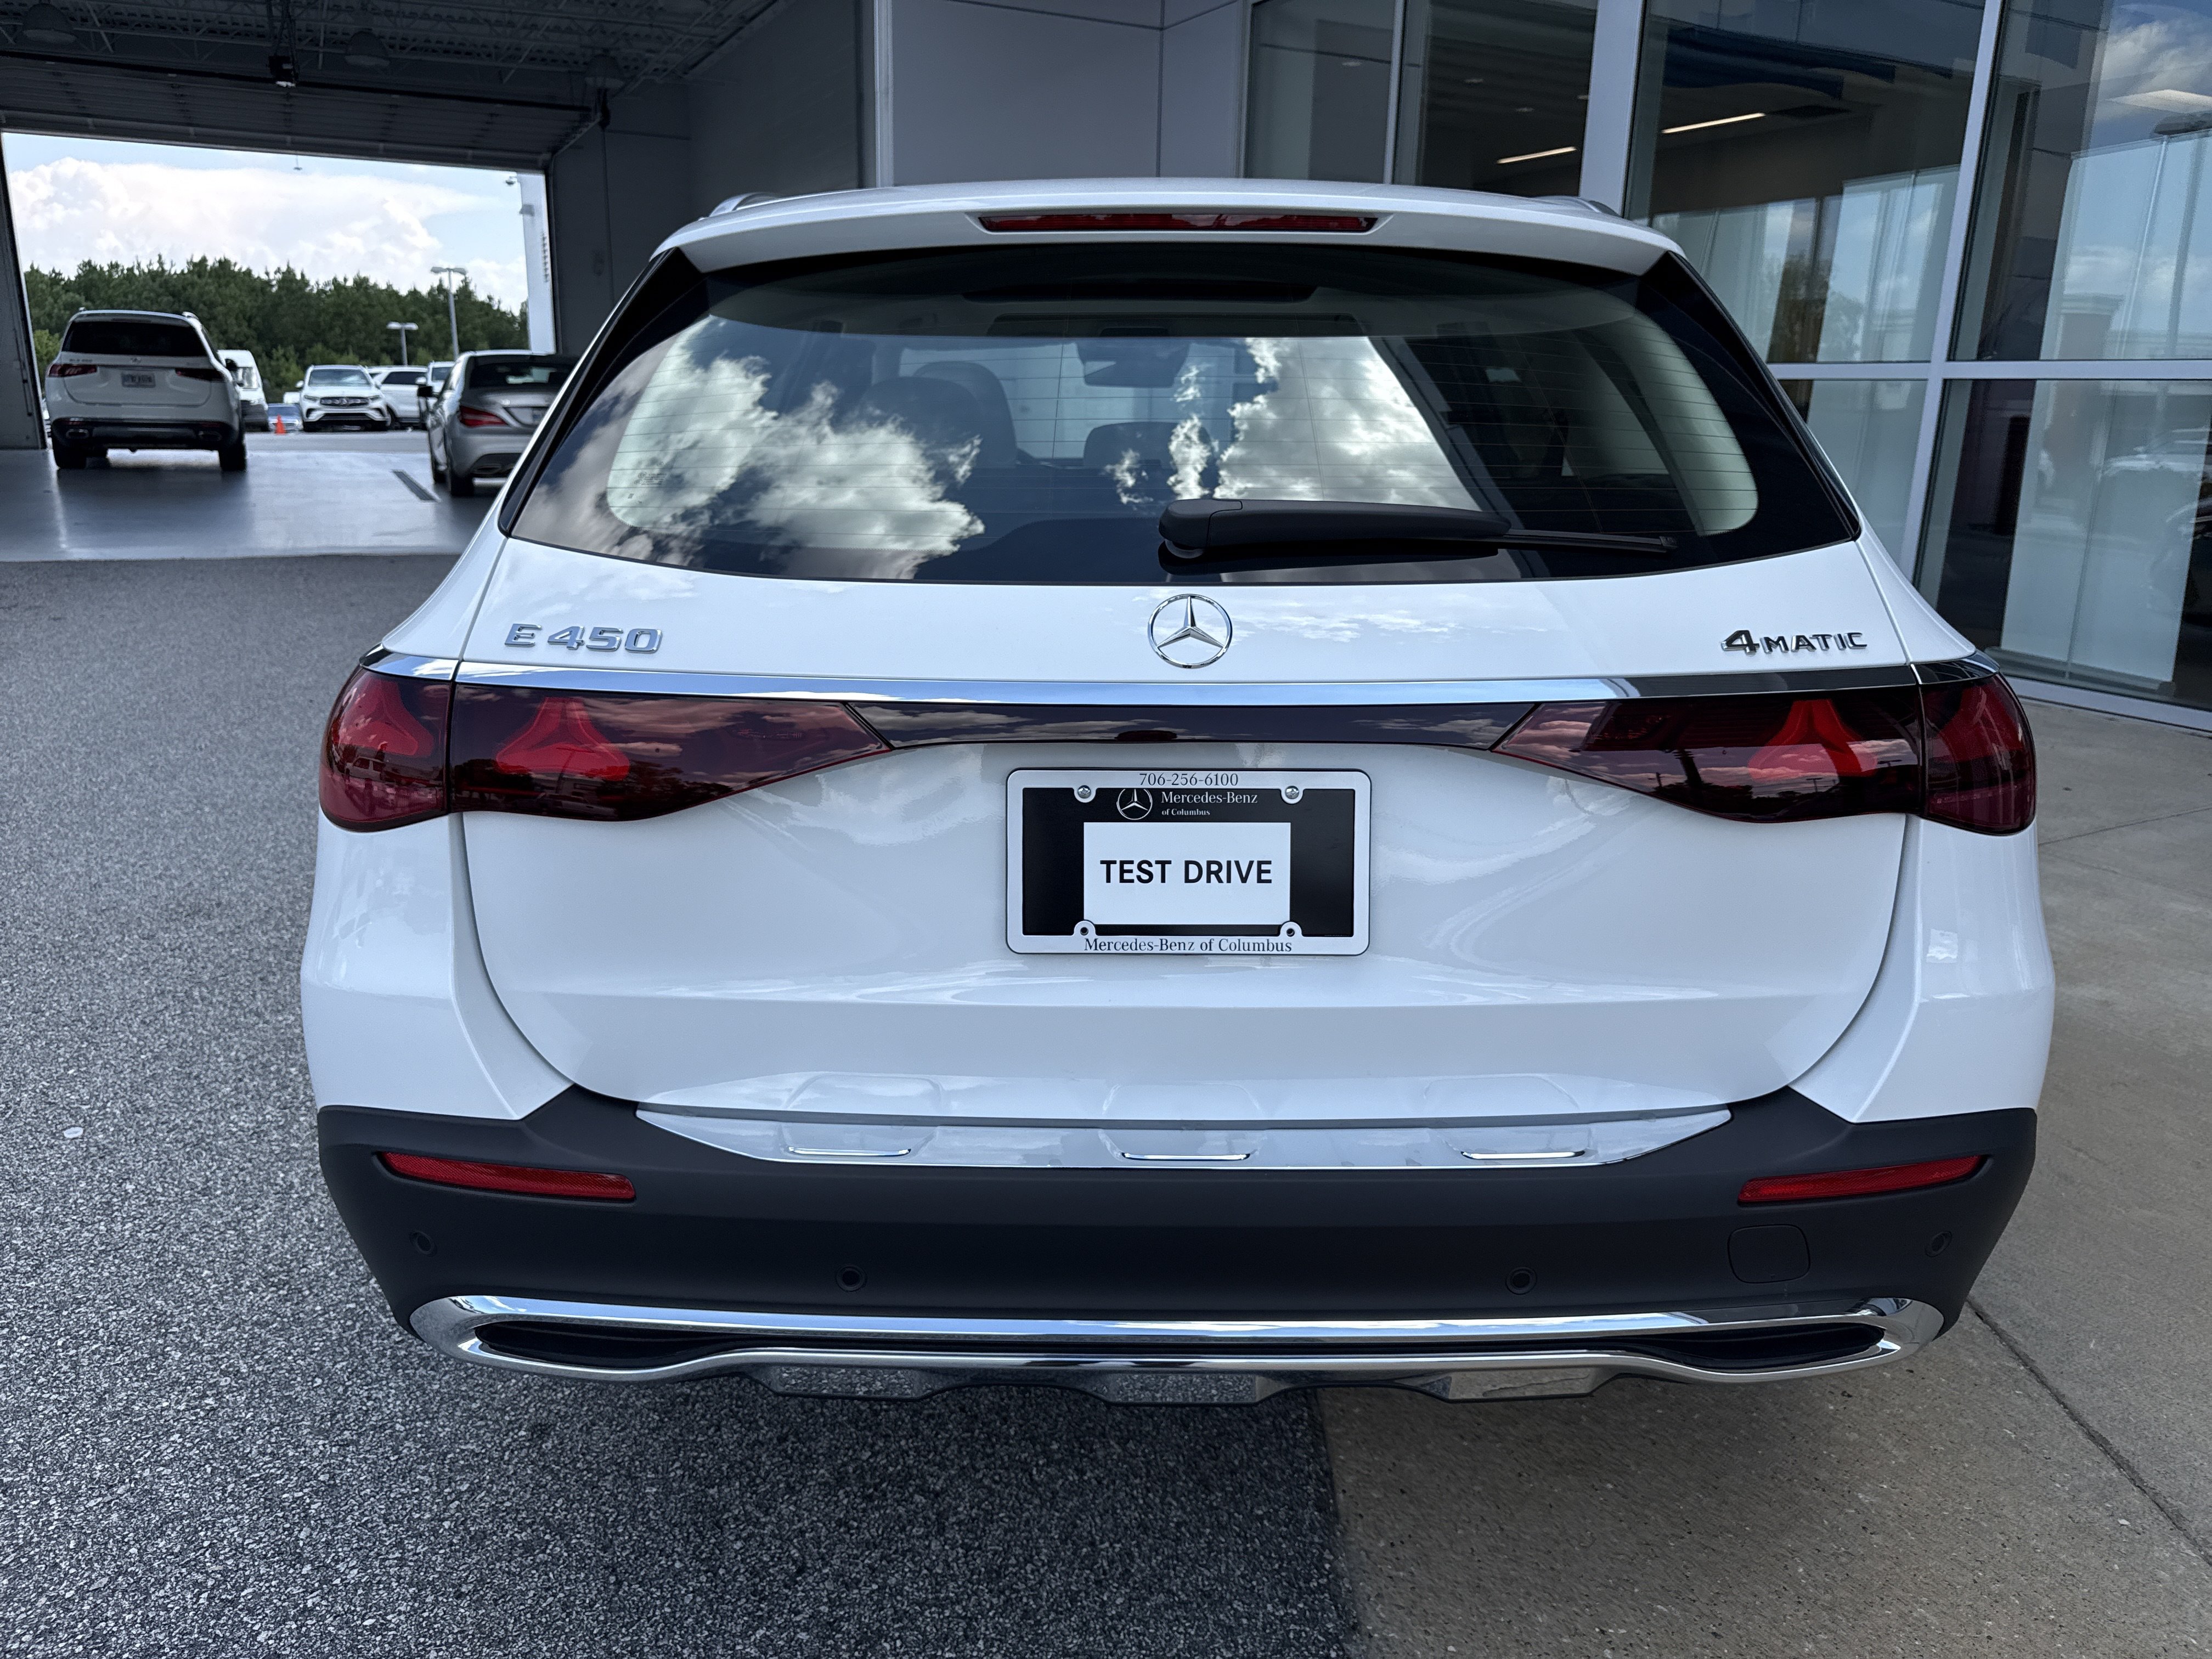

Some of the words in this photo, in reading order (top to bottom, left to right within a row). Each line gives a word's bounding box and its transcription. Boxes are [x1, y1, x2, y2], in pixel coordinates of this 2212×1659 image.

[505, 623, 541, 647] E
[548, 625, 663, 653] 450
[1720, 630, 1867, 656] 4MATIC
[1139, 772, 1239, 786] 706-256-6100
[1161, 791, 1259, 804] Mercedes-Benz
[1099, 859, 1172, 884] TEST
[1184, 860, 1273, 884] DRIVE
[1084, 938, 1195, 952] Mercedes-Benz
[1200, 938, 1215, 951] of
[1218, 938, 1292, 952] Columbus
